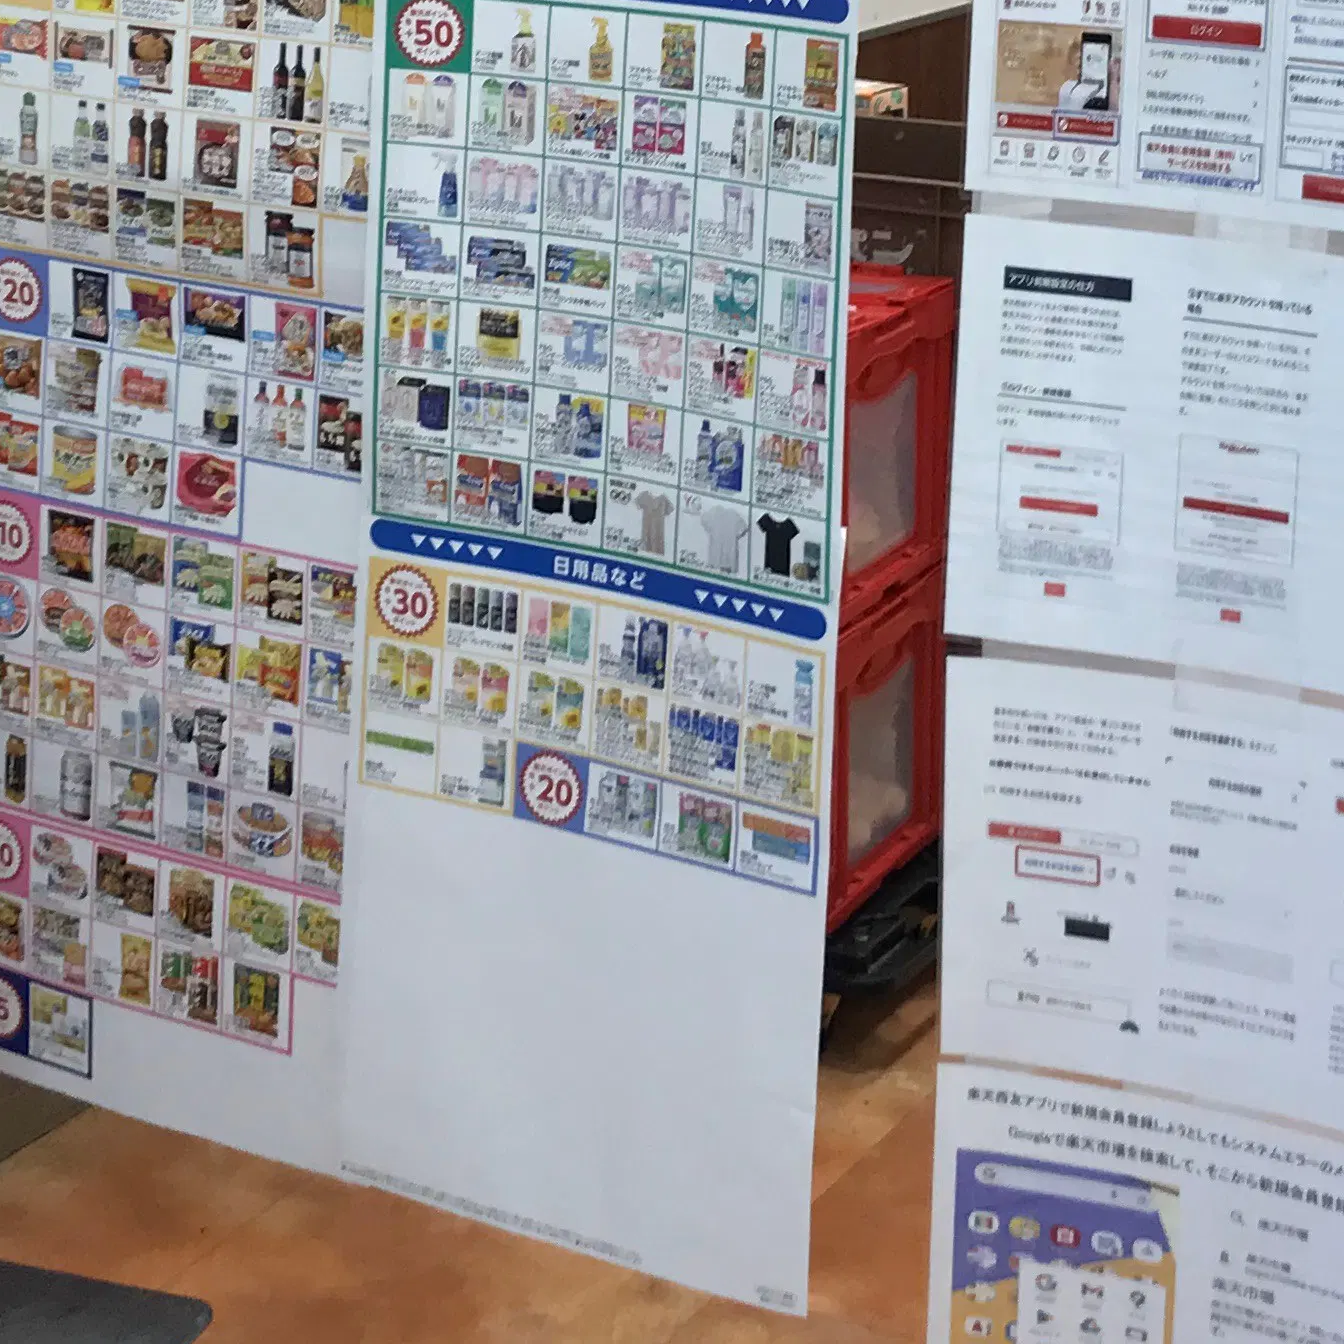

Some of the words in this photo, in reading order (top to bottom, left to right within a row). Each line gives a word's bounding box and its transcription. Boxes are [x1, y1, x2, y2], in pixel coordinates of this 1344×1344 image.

[413, 18, 453, 49] 50
[3, 277, 34, 306] 20
[552, 555, 646, 592] 日用品など
[391, 587, 428, 620] 30
[536, 774, 574, 806] 20
